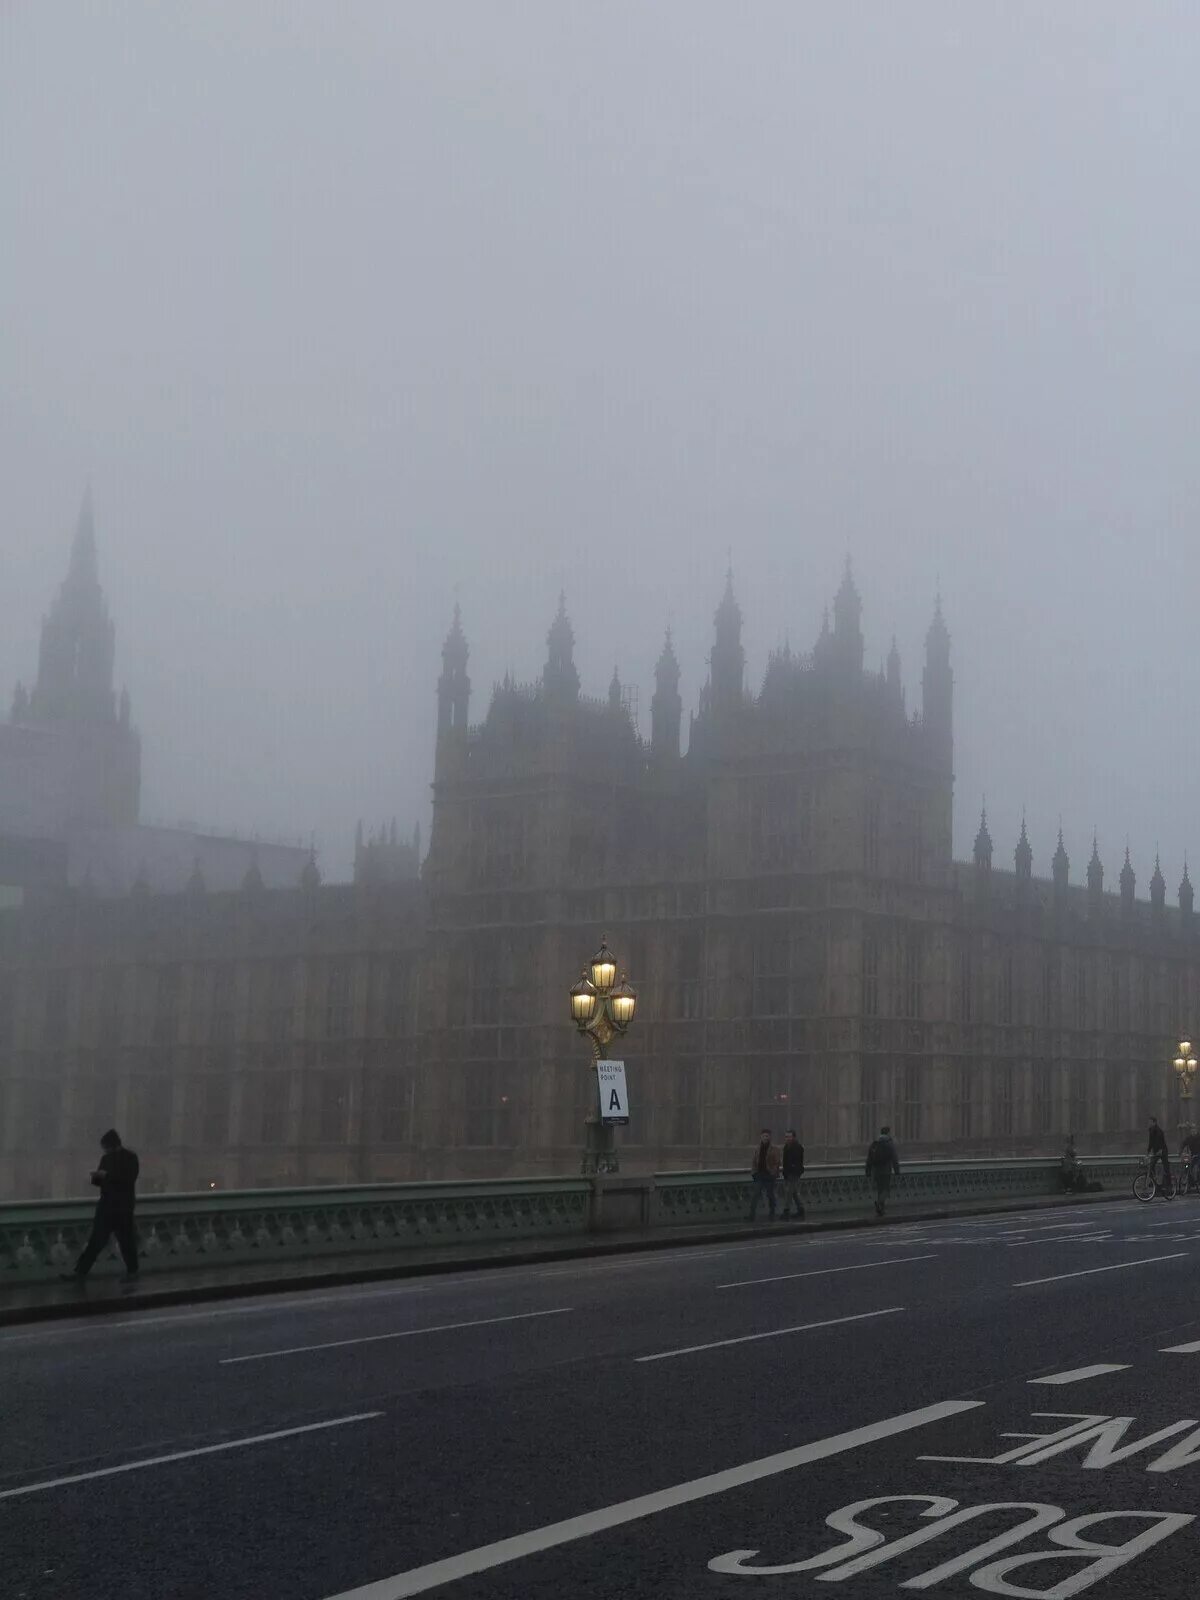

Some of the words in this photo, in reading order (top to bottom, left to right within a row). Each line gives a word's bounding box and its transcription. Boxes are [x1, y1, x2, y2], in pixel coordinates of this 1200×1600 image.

[600, 1065, 622, 1073] MEETING
[609, 1089, 621, 1110] A
[707, 1495, 1197, 1600] BUS
